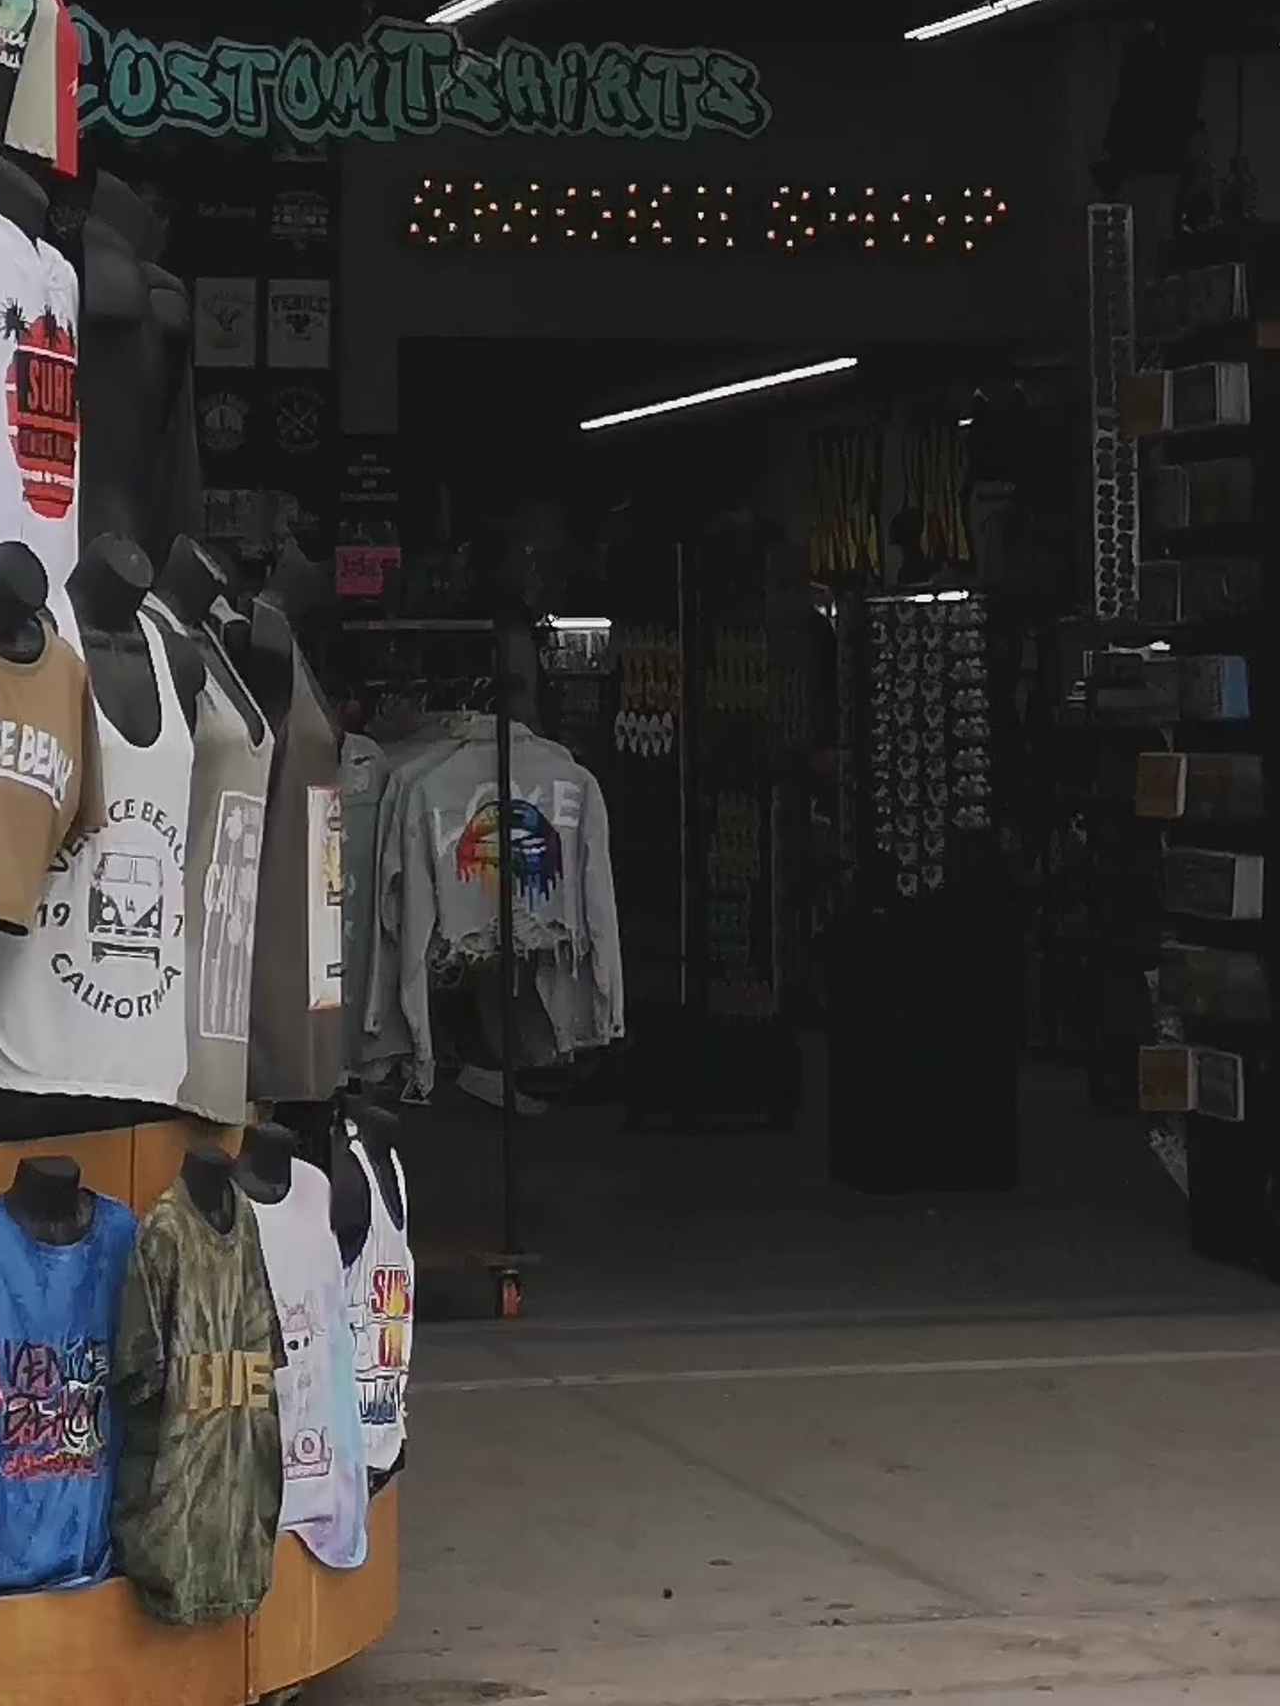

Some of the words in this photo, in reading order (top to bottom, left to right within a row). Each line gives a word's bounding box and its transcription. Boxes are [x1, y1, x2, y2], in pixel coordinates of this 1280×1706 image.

[409, 177, 737, 248] SMOKE
[766, 184, 1009, 250] SHOP
[48, 799, 136, 874] VECE
[140, 801, 185, 886] BEAC
[50, 952, 182, 1020] CALIFORNIA
